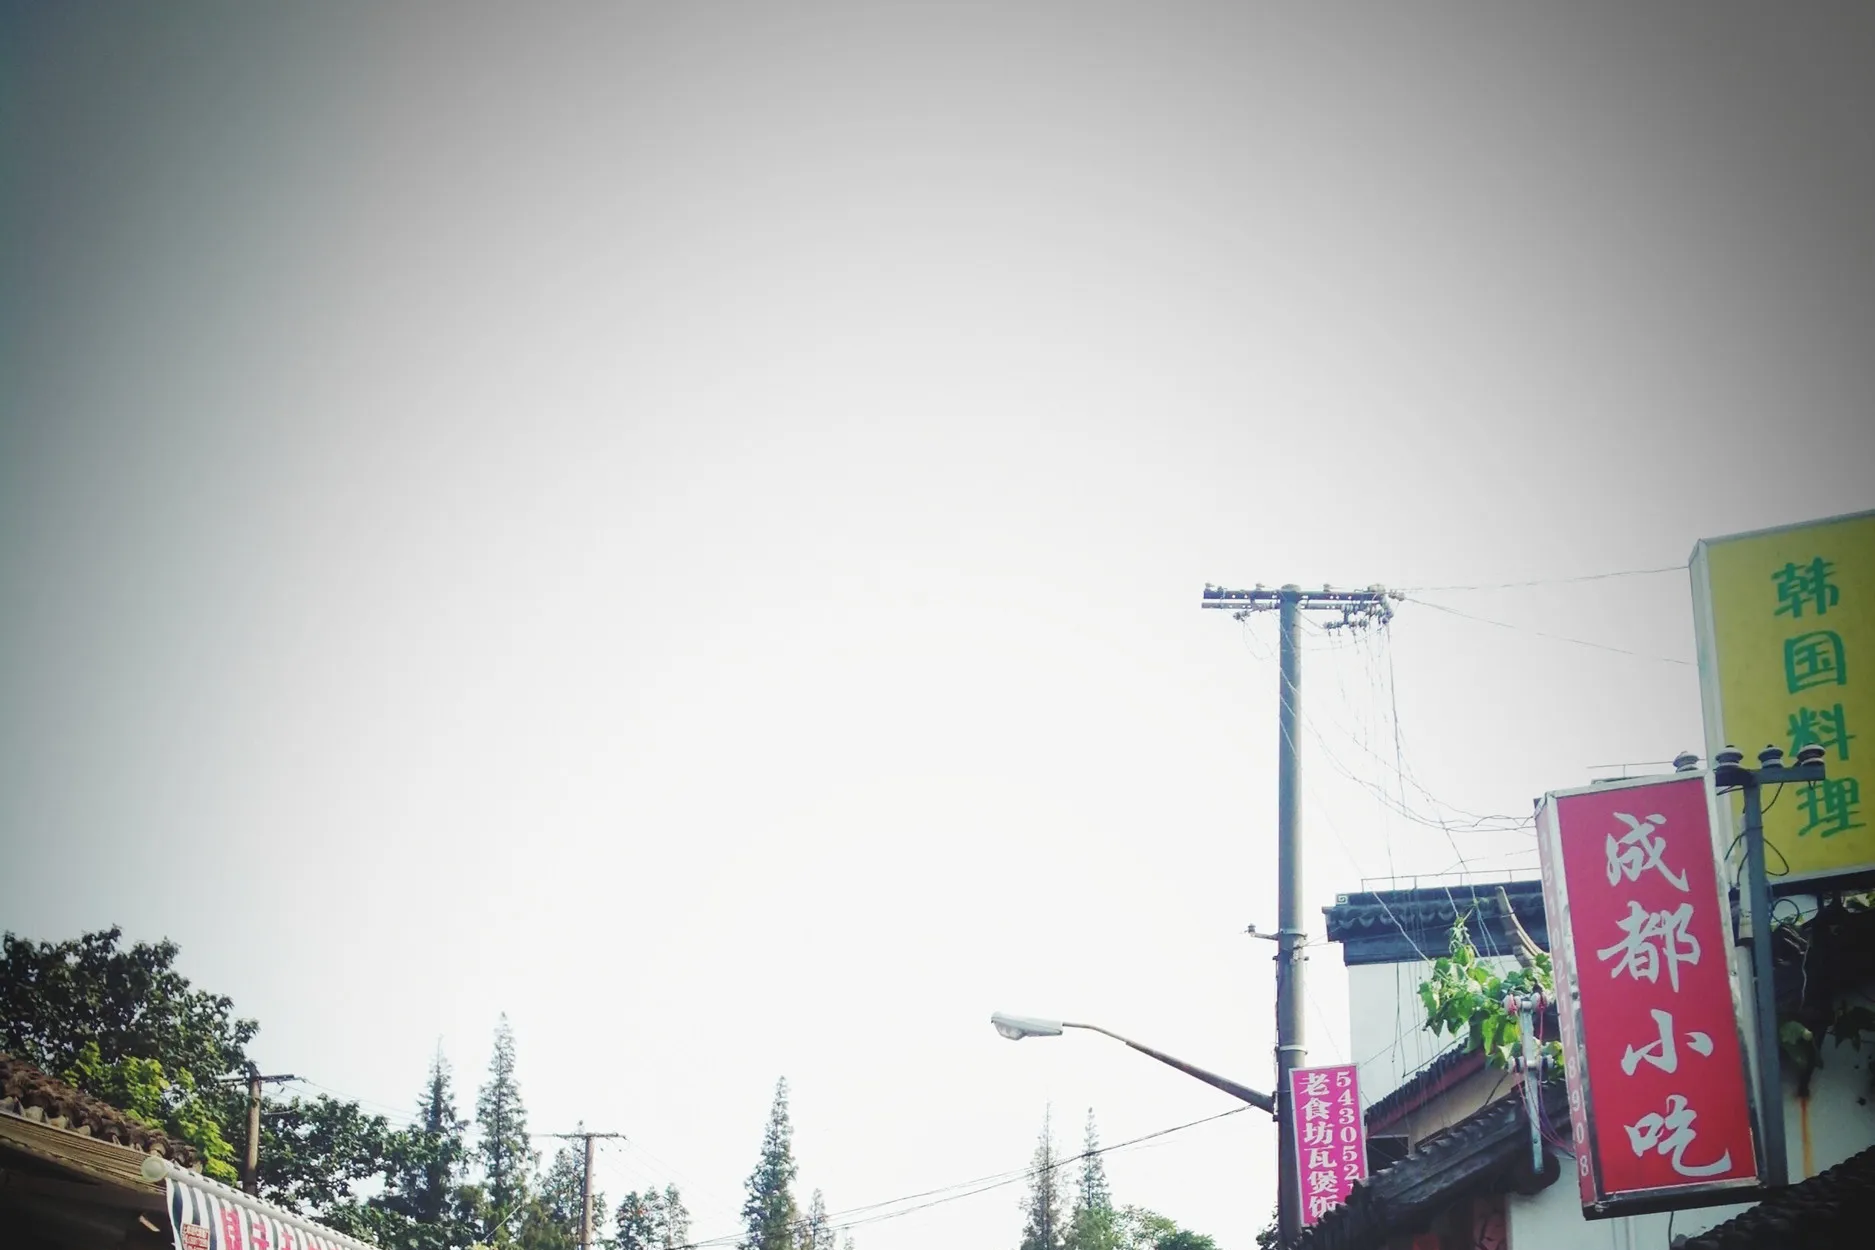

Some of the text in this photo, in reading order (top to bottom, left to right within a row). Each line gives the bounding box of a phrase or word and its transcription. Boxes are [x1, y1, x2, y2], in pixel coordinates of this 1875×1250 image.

[1770, 556, 1867, 839] 韩国料理
[1597, 811, 1734, 1177] 成都小吃
[1299, 1072, 1340, 1219] 老食坊瓦煲饭
